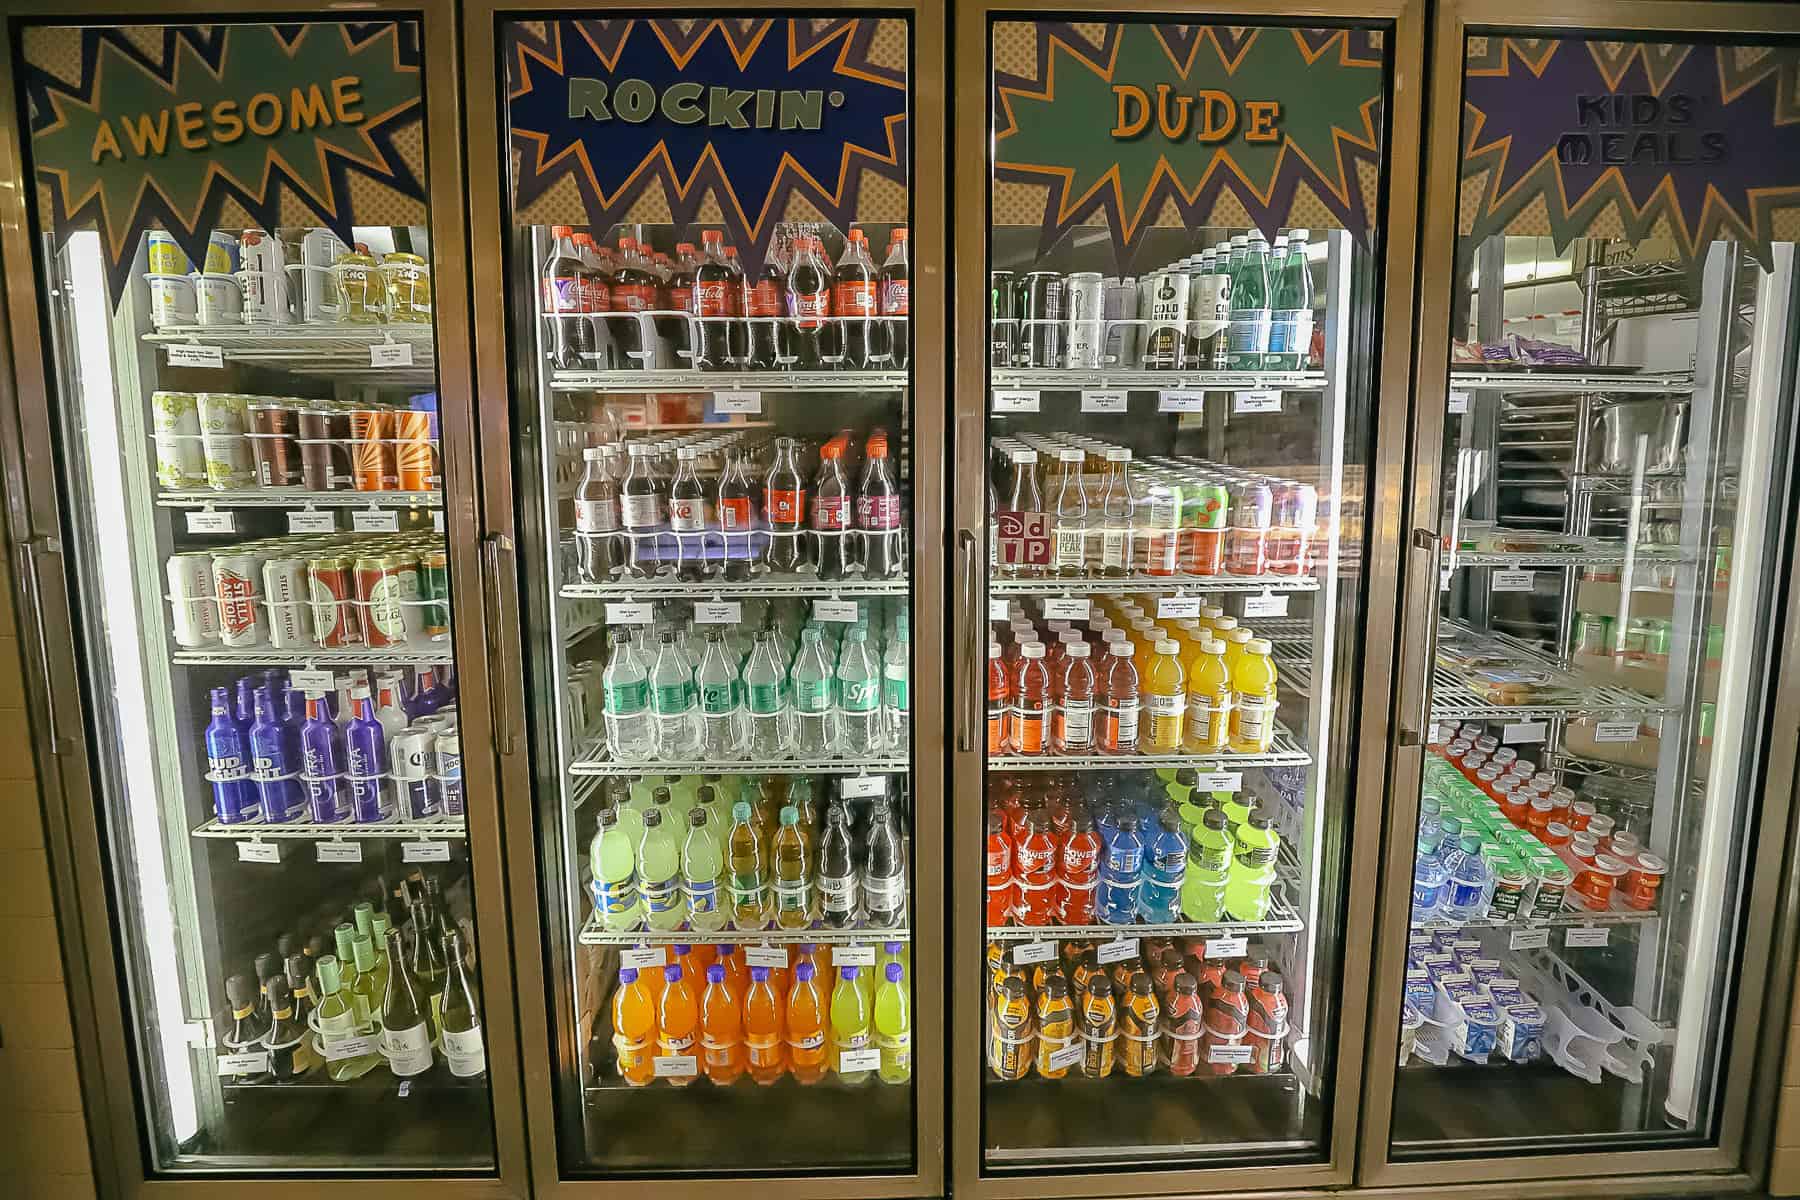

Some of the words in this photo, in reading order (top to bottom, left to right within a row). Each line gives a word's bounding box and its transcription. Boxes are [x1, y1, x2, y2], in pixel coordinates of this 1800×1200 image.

[91, 76, 366, 164] AWESOME
[568, 77, 845, 130] ROCKIN'
[1111, 85, 1279, 142] DUDE
[1556, 131, 1727, 167] MEALS
[1154, 304, 1179, 313] COLD
